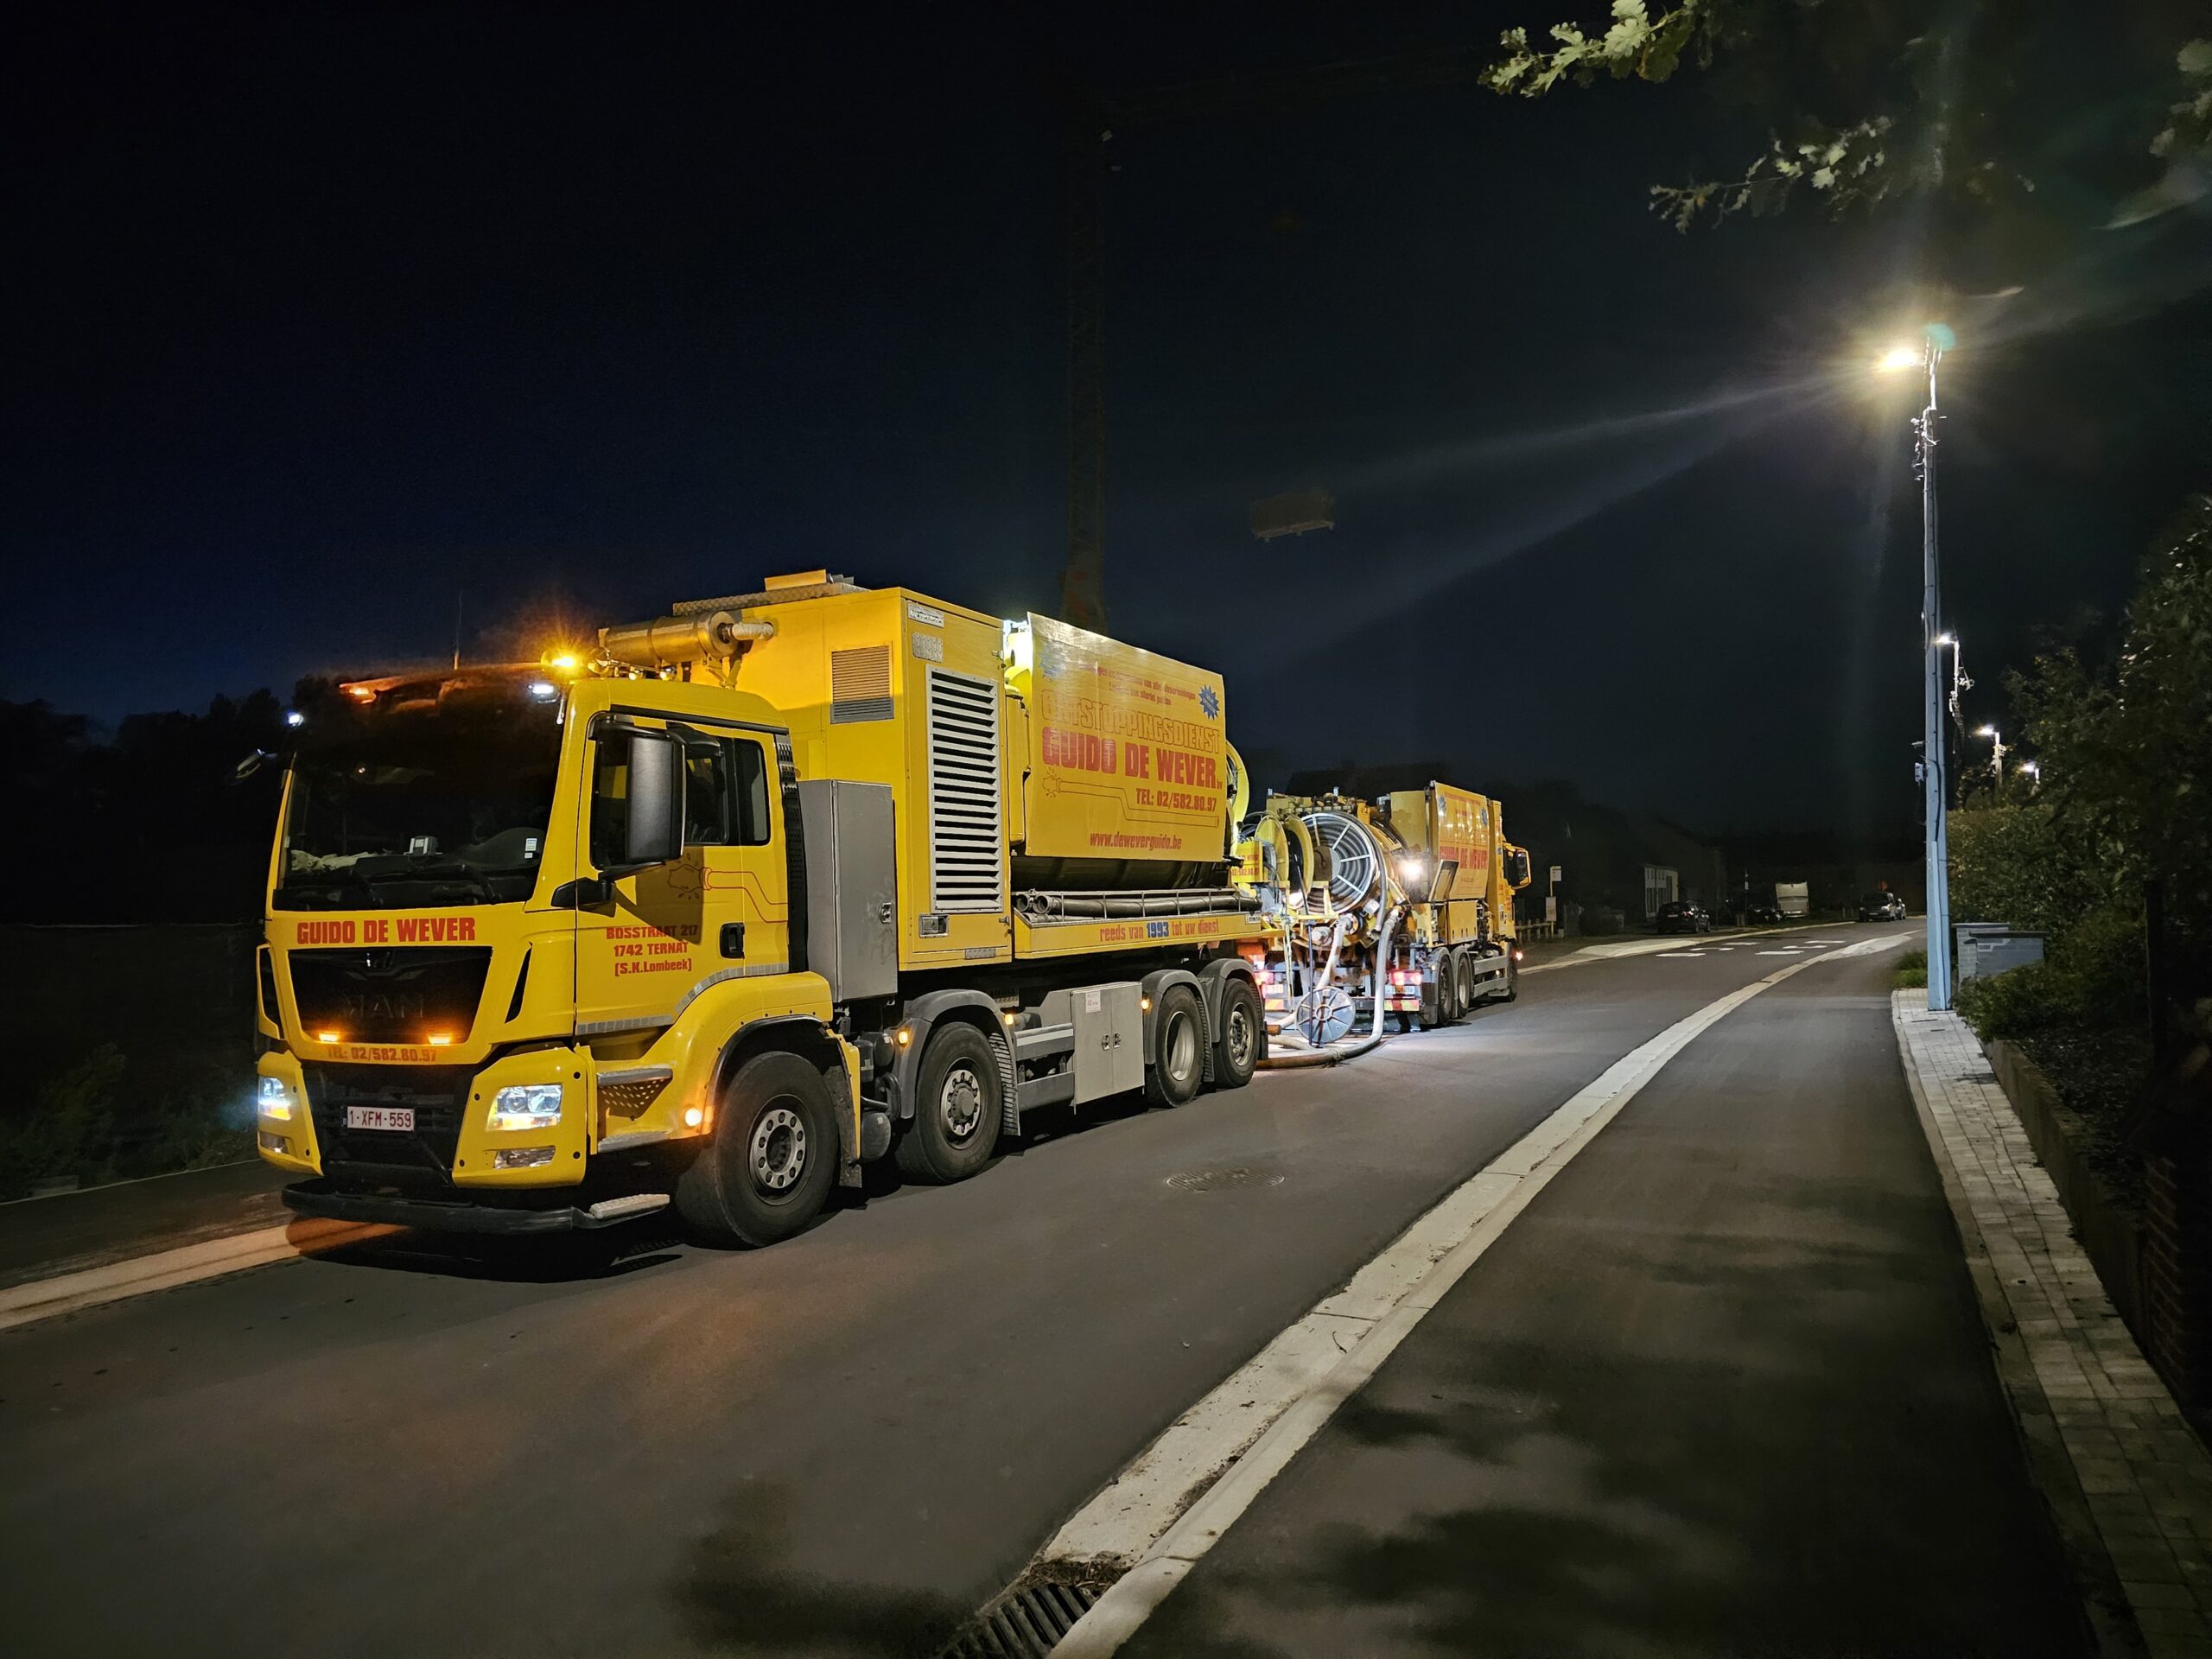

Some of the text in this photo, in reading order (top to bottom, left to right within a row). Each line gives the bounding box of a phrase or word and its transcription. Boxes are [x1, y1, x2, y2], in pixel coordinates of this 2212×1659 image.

[1042, 690, 1219, 753] OTSTOPPINGSDIENST
[1042, 727, 1116, 774] GUIDO
[1125, 742, 1149, 779] DE
[1156, 747, 1217, 790] WEVER
[1136, 788, 1217, 812] TEL: 02/582.80.97
[1090, 831, 1182, 851] www.deweverguido.be
[297, 917, 475, 944] GUIDO DE WEVER
[607, 925, 698, 939] BOSSTRAAT 217
[1100, 918, 1219, 942] reeds van 1993 tot uw dienst
[613, 942, 689, 957] 1742 TERNAT
[351, 1047, 437, 1062] 02/582.80.97
